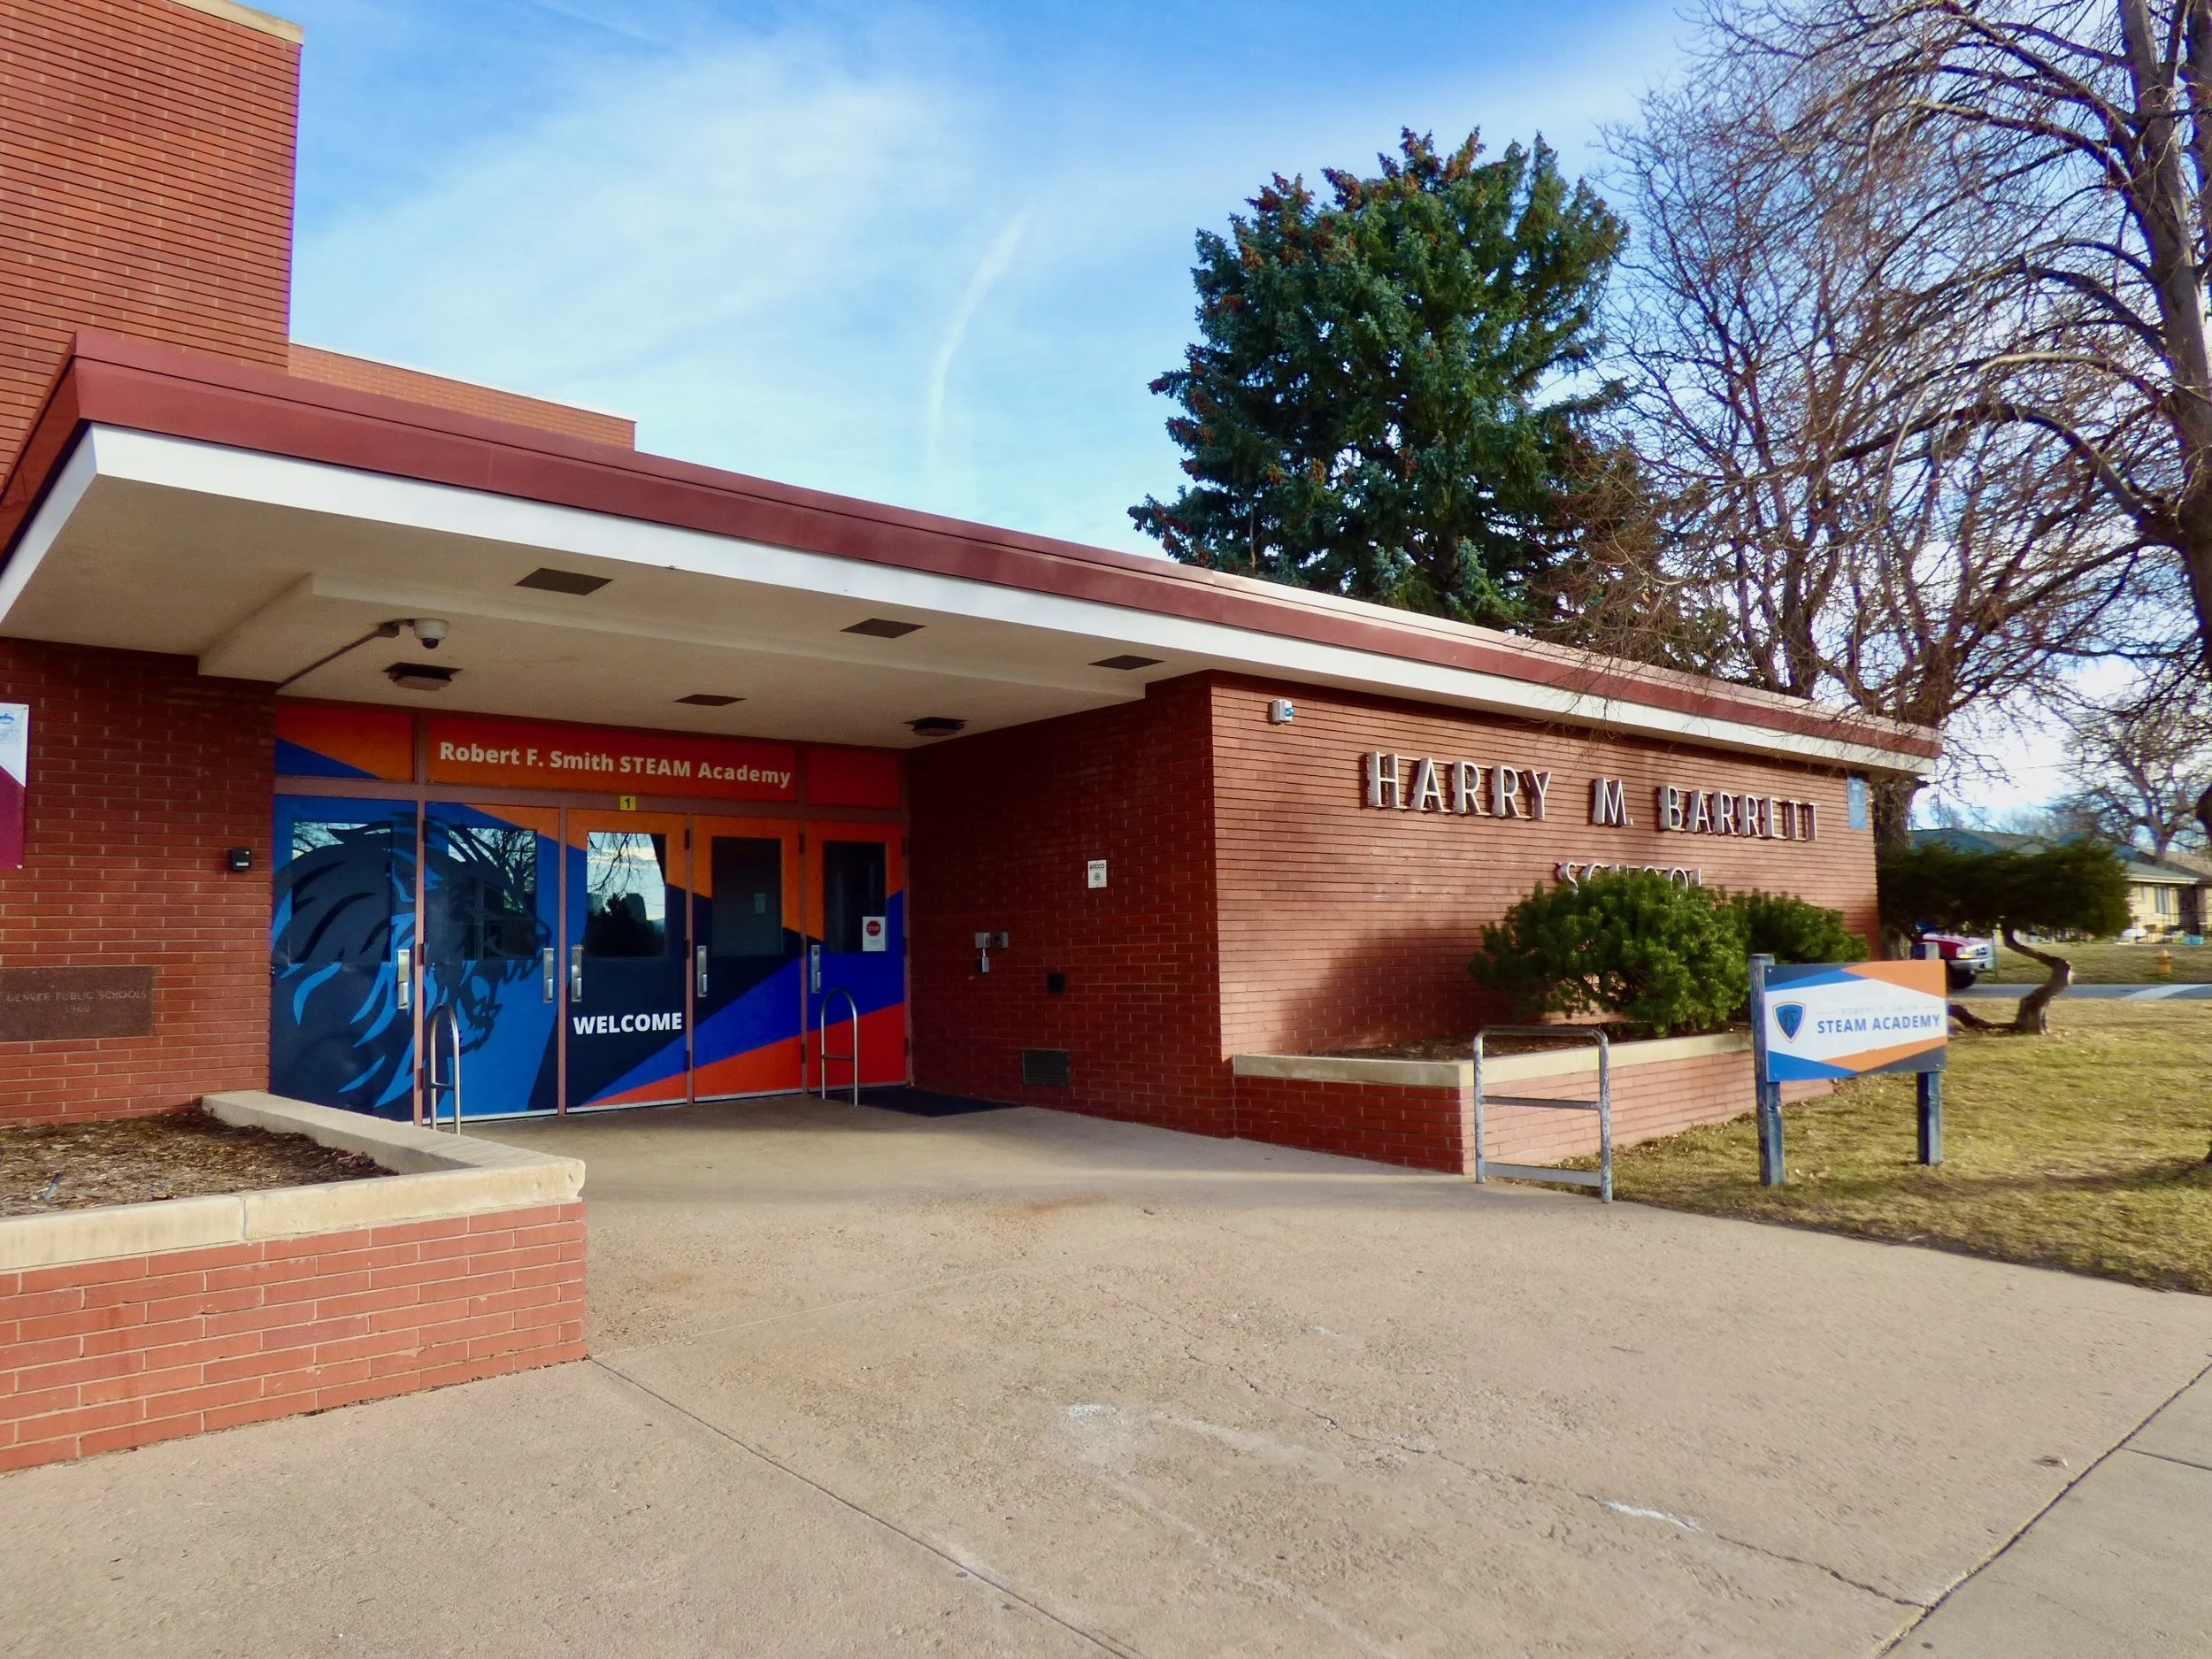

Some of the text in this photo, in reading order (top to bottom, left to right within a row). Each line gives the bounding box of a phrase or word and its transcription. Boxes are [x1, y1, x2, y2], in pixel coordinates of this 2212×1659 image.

[440, 742, 791, 789] Robert F. Smith STEAM Academy
[624, 797, 631, 810] 1
[1369, 751, 1820, 841] HARRY M. BARRETT
[56, 990, 94, 1002] PUBLIC
[98, 989, 147, 1000] SCHOOLS
[572, 1012, 683, 1035] WELCOME
[1816, 1014, 1940, 1034] STEAM ACADEMY
